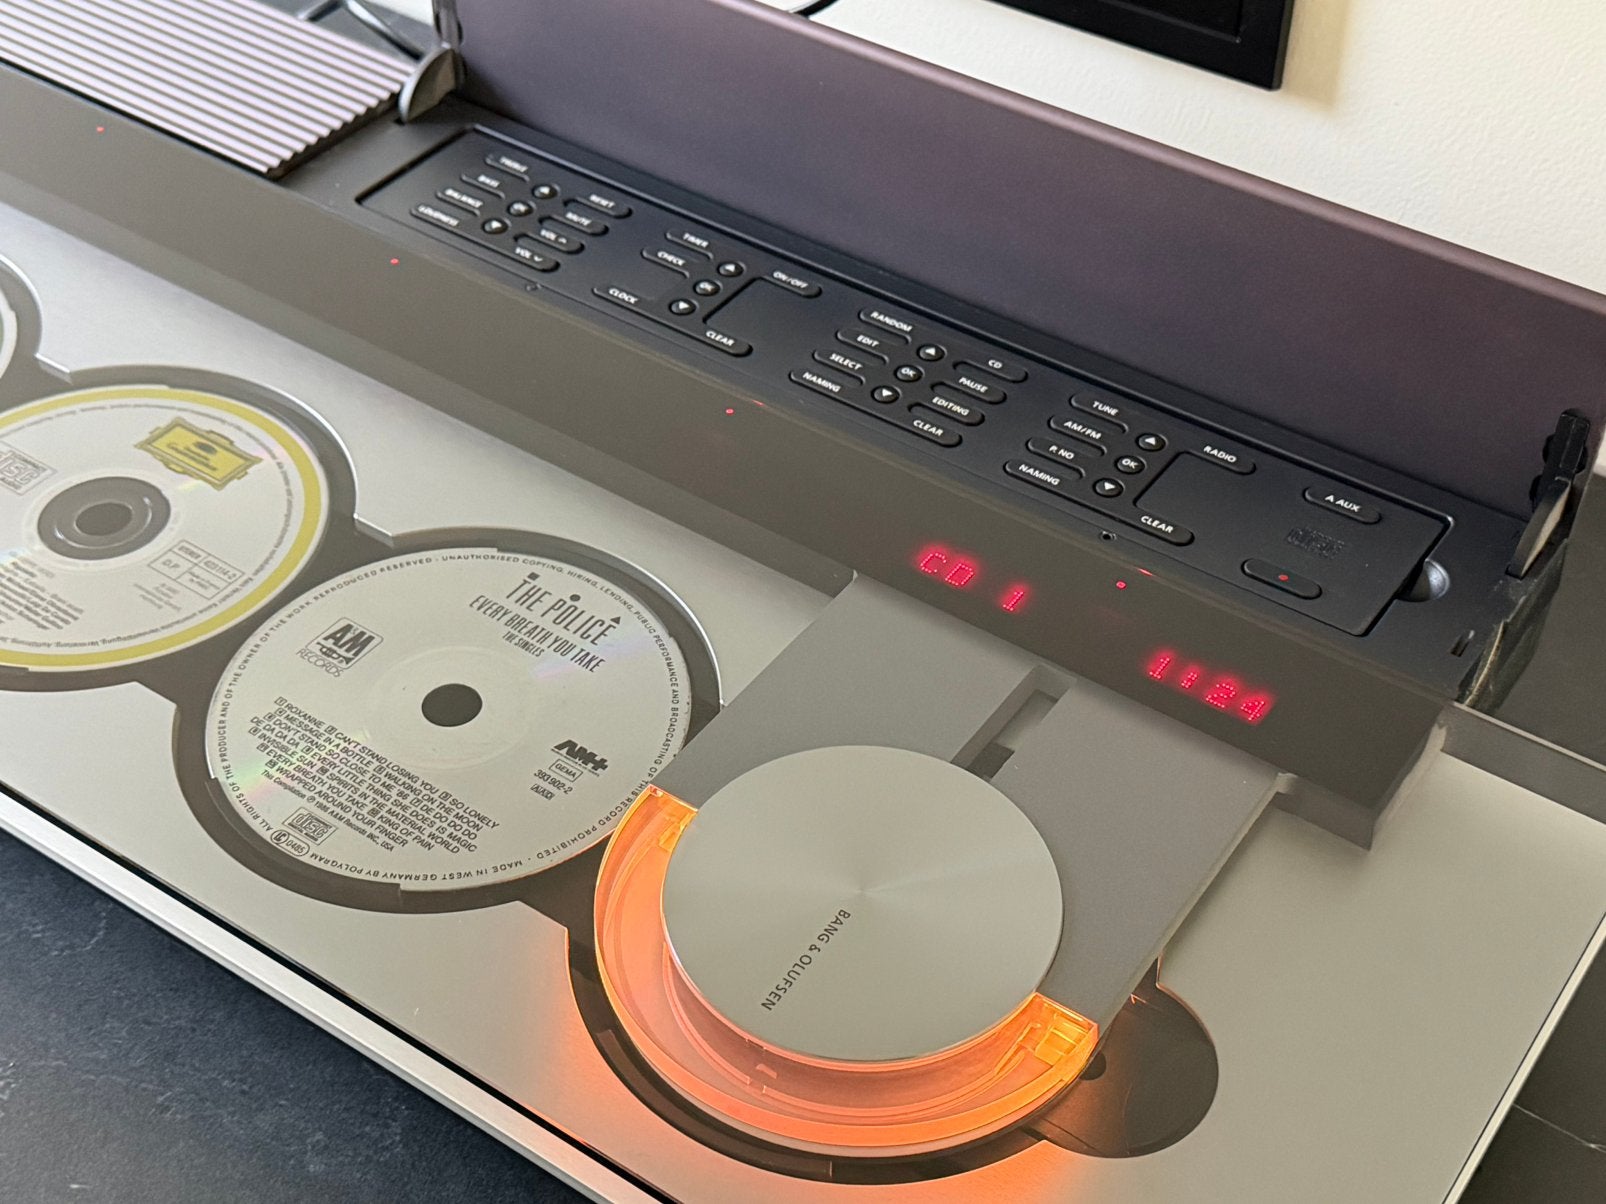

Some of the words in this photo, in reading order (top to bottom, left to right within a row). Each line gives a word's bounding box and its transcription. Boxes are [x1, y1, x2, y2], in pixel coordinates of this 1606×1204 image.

[565, 211, 592, 226] MUTE
[683, 233, 709, 248] TIMER
[657, 251, 685, 267] CHECK
[773, 271, 808, 289] ON/OFF
[609, 288, 638, 304] CLOCK
[870, 311, 912, 332] RANDOM
[706, 330, 735, 347] CLEAR
[856, 335, 880, 348] EDIT
[829, 353, 863, 370] SELECT
[988, 359, 1003, 369] CD
[900, 367, 915, 378] OK
[802, 372, 841, 392] NAMING
[958, 377, 988, 393] PAUSE
[932, 396, 970, 416] EDITING
[1092, 401, 1118, 416] TUNE
[913, 419, 943, 436] CLEAR
[1063, 420, 1102, 440] AM/FM
[1203, 445, 1237, 463] RADIO
[1121, 458, 1138, 469] OK
[1018, 463, 1060, 485] NAMING
[1325, 494, 1335, 503] A
[1335, 499, 1361, 512] AUX
[1140, 515, 1174, 534] CLEAR
[380, 557, 432, 573] RESERVED
[442, 554, 520, 563] UNAUTHORISED
[313, 570, 377, 601] REPRODUCED
[919, 552, 975, 587] CD
[1002, 590, 1024, 612] 1
[285, 602, 312, 618] WORK
[506, 578, 552, 612] THE
[541, 598, 617, 646] POLICE
[269, 619, 287, 632] THE
[634, 610, 656, 634] PUBLIC
[259, 633, 270, 642] OF
[469, 594, 512, 622] EVERY
[504, 613, 553, 645] BREATH
[547, 635, 577, 657] YOU
[570, 648, 606, 673] TAKE
[502, 631, 517, 643] THE
[514, 638, 545, 657] SINGLES
[238, 643, 261, 670] OWNER
[296, 648, 344, 677] RECORDS
[653, 635, 679, 687] PERFORMANCE
[228, 672, 242, 687] THE
[224, 689, 233, 699] OF
[671, 689, 680, 704] AND
[1148, 656, 1266, 721] 1:24
[219, 701, 230, 717] AND
[217, 720, 229, 763] PRODUCER
[653, 707, 679, 765] BROADCASTING
[222, 764, 234, 780] THE
[284, 703, 326, 729] ROXANNE
[334, 732, 361, 749] CAN'T
[359, 746, 388, 765] STAND
[386, 761, 420, 784] LOSING
[419, 780, 439, 794] YOU
[450, 798, 465, 809] SO
[463, 806, 500, 829] LONELY
[284, 714, 326, 740] MESSAGE
[323, 736, 335, 745] IN
[340, 746, 374, 768] BOTTLE
[384, 771, 423, 797] WALKING
[421, 794, 436, 805] ON
[435, 800, 455, 815] THE
[453, 812, 483, 832] MOON
[555, 763, 577, 778] GEMA
[647, 767, 658, 778] OF
[229, 782, 240, 792] OF
[250, 716, 265, 727] DE
[262, 724, 276, 734] DA
[274, 730, 288, 741] DA
[287, 738, 300, 749] DA
[311, 752, 340, 771] EVERY
[337, 768, 367, 787] LITTLE
[365, 782, 392, 802] THING
[391, 797, 412, 813] SHE
[410, 810, 436, 829] DOES
[435, 825, 448, 835] IS
[447, 832, 478, 853] MAGIC
[273, 718, 301, 736] DON'T
[298, 733, 327, 752] STAND
[325, 748, 340, 759] SO
[339, 757, 370, 777] CLOSE
[368, 773, 382, 784] TO
[380, 781, 396, 793] ME
[420, 804, 436, 815] DE
[433, 811, 449, 823] DO
[447, 820, 463, 832] DO
[461, 828, 477, 840] DO
[548, 777, 574, 794] 902-2
[258, 732, 299, 759] INVISIBLE
[297, 755, 317, 770] SUN
[326, 772, 360, 794] SPIRITS
[358, 791, 370, 800] IN
[369, 797, 388, 810] THE
[386, 808, 426, 836] MATERIAL
[427, 832, 461, 854] WORLD
[631, 780, 649, 796] THIS
[236, 793, 261, 820] RIGHTS
[266, 749, 296, 767] EVERY
[293, 765, 328, 788] BREATH
[326, 783, 346, 798] YOU
[345, 795, 368, 810] TAKE
[377, 813, 401, 831] KING
[399, 828, 415, 838] OF
[412, 835, 436, 851] PAIN
[276, 765, 317, 792] WRAPPED
[314, 790, 352, 813] AROUND
[352, 810, 377, 828] YOUR
[375, 822, 409, 847] FINGER
[598, 797, 633, 826] RECORD
[259, 818, 274, 832] ALL
[380, 841, 396, 852] USA
[536, 825, 598, 859] PROHIBITED
[310, 852, 364, 874] POLYGRAM
[492, 860, 523, 873] MADE
[365, 869, 380, 877] BY
[382, 872, 438, 881] GERMANY
[441, 871, 473, 880] WEST
[476, 868, 488, 876] IN
[817, 909, 851, 944] BANG
[808, 944, 821, 953] &
[760, 954, 813, 1011] OLUFSEN
